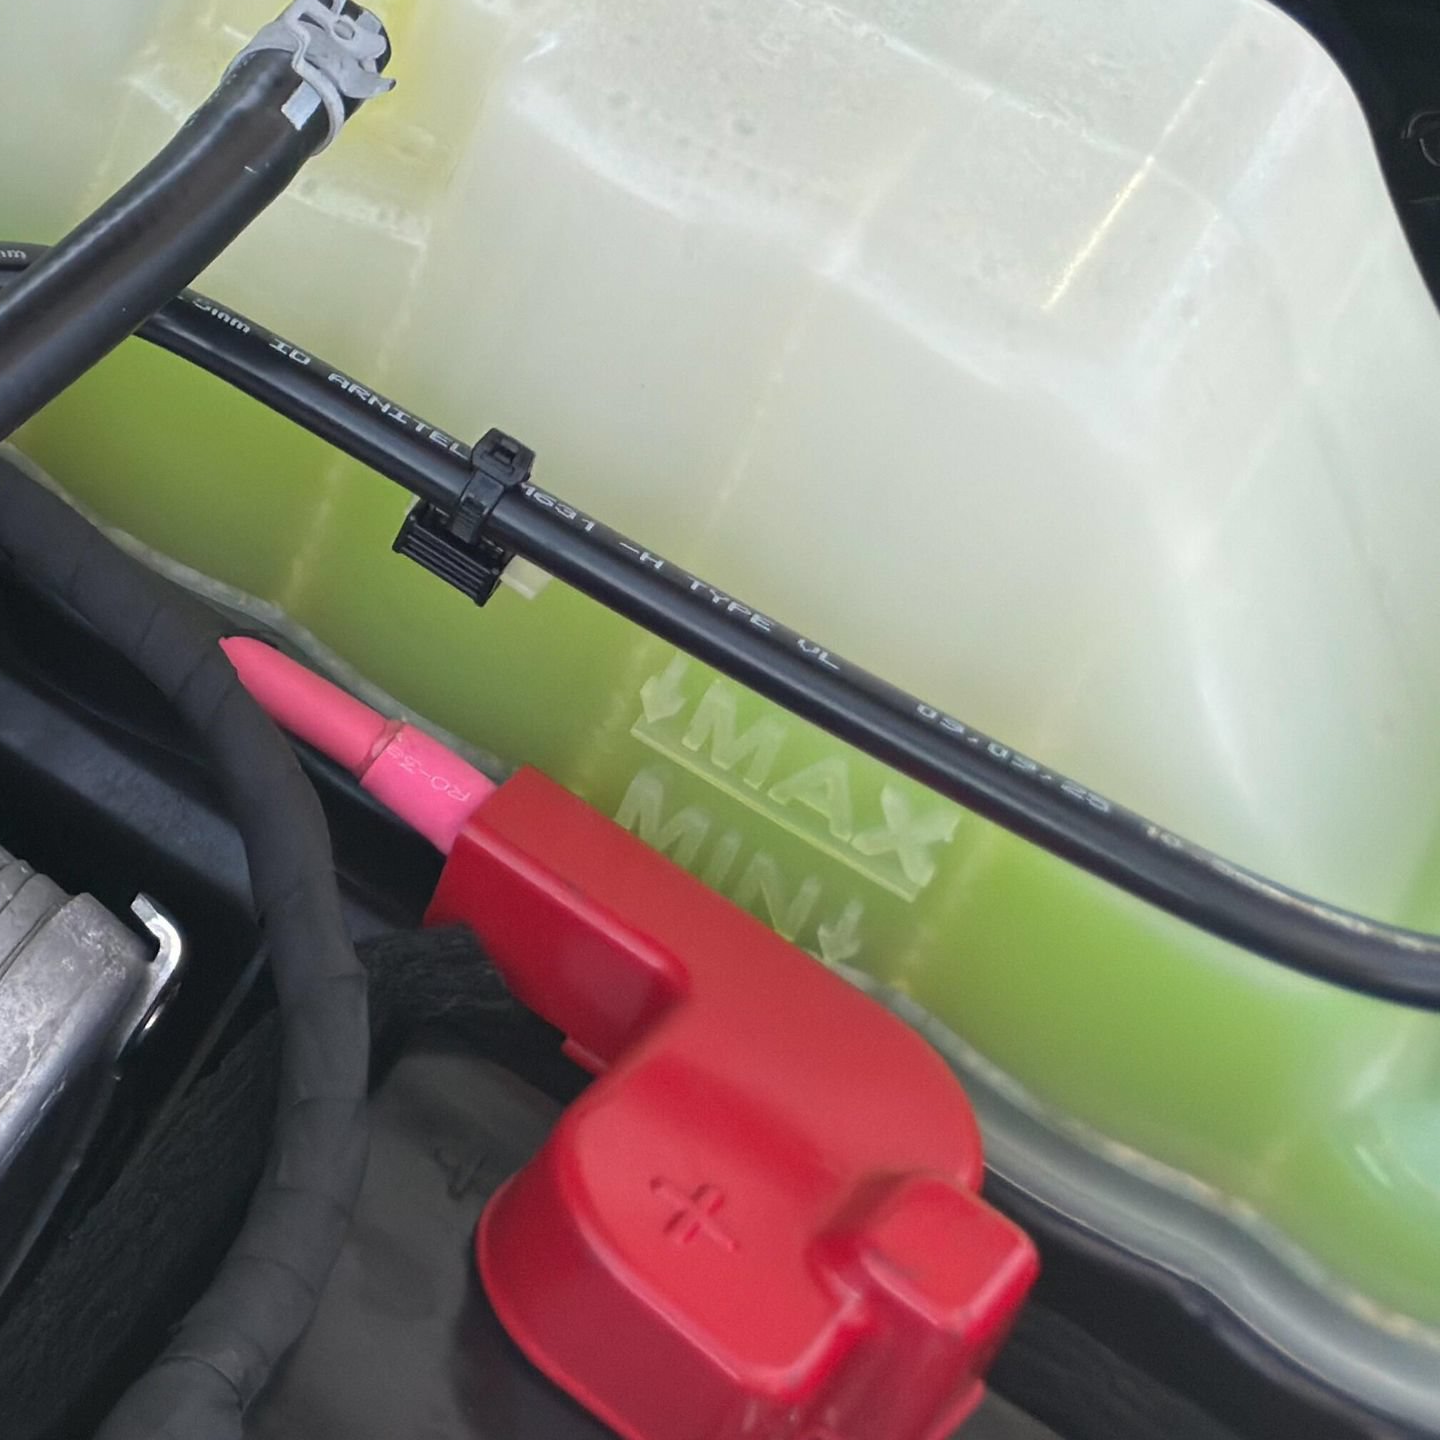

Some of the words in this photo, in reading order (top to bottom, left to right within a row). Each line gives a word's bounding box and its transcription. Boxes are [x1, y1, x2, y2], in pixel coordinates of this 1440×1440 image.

[268, 338, 312, 366] ID
[328, 371, 471, 461] ARNITEL
[687, 576, 773, 631] TYPE
[796, 638, 840, 671] VL
[614, 767, 822, 942] MIN
[681, 680, 961, 887] MAX
